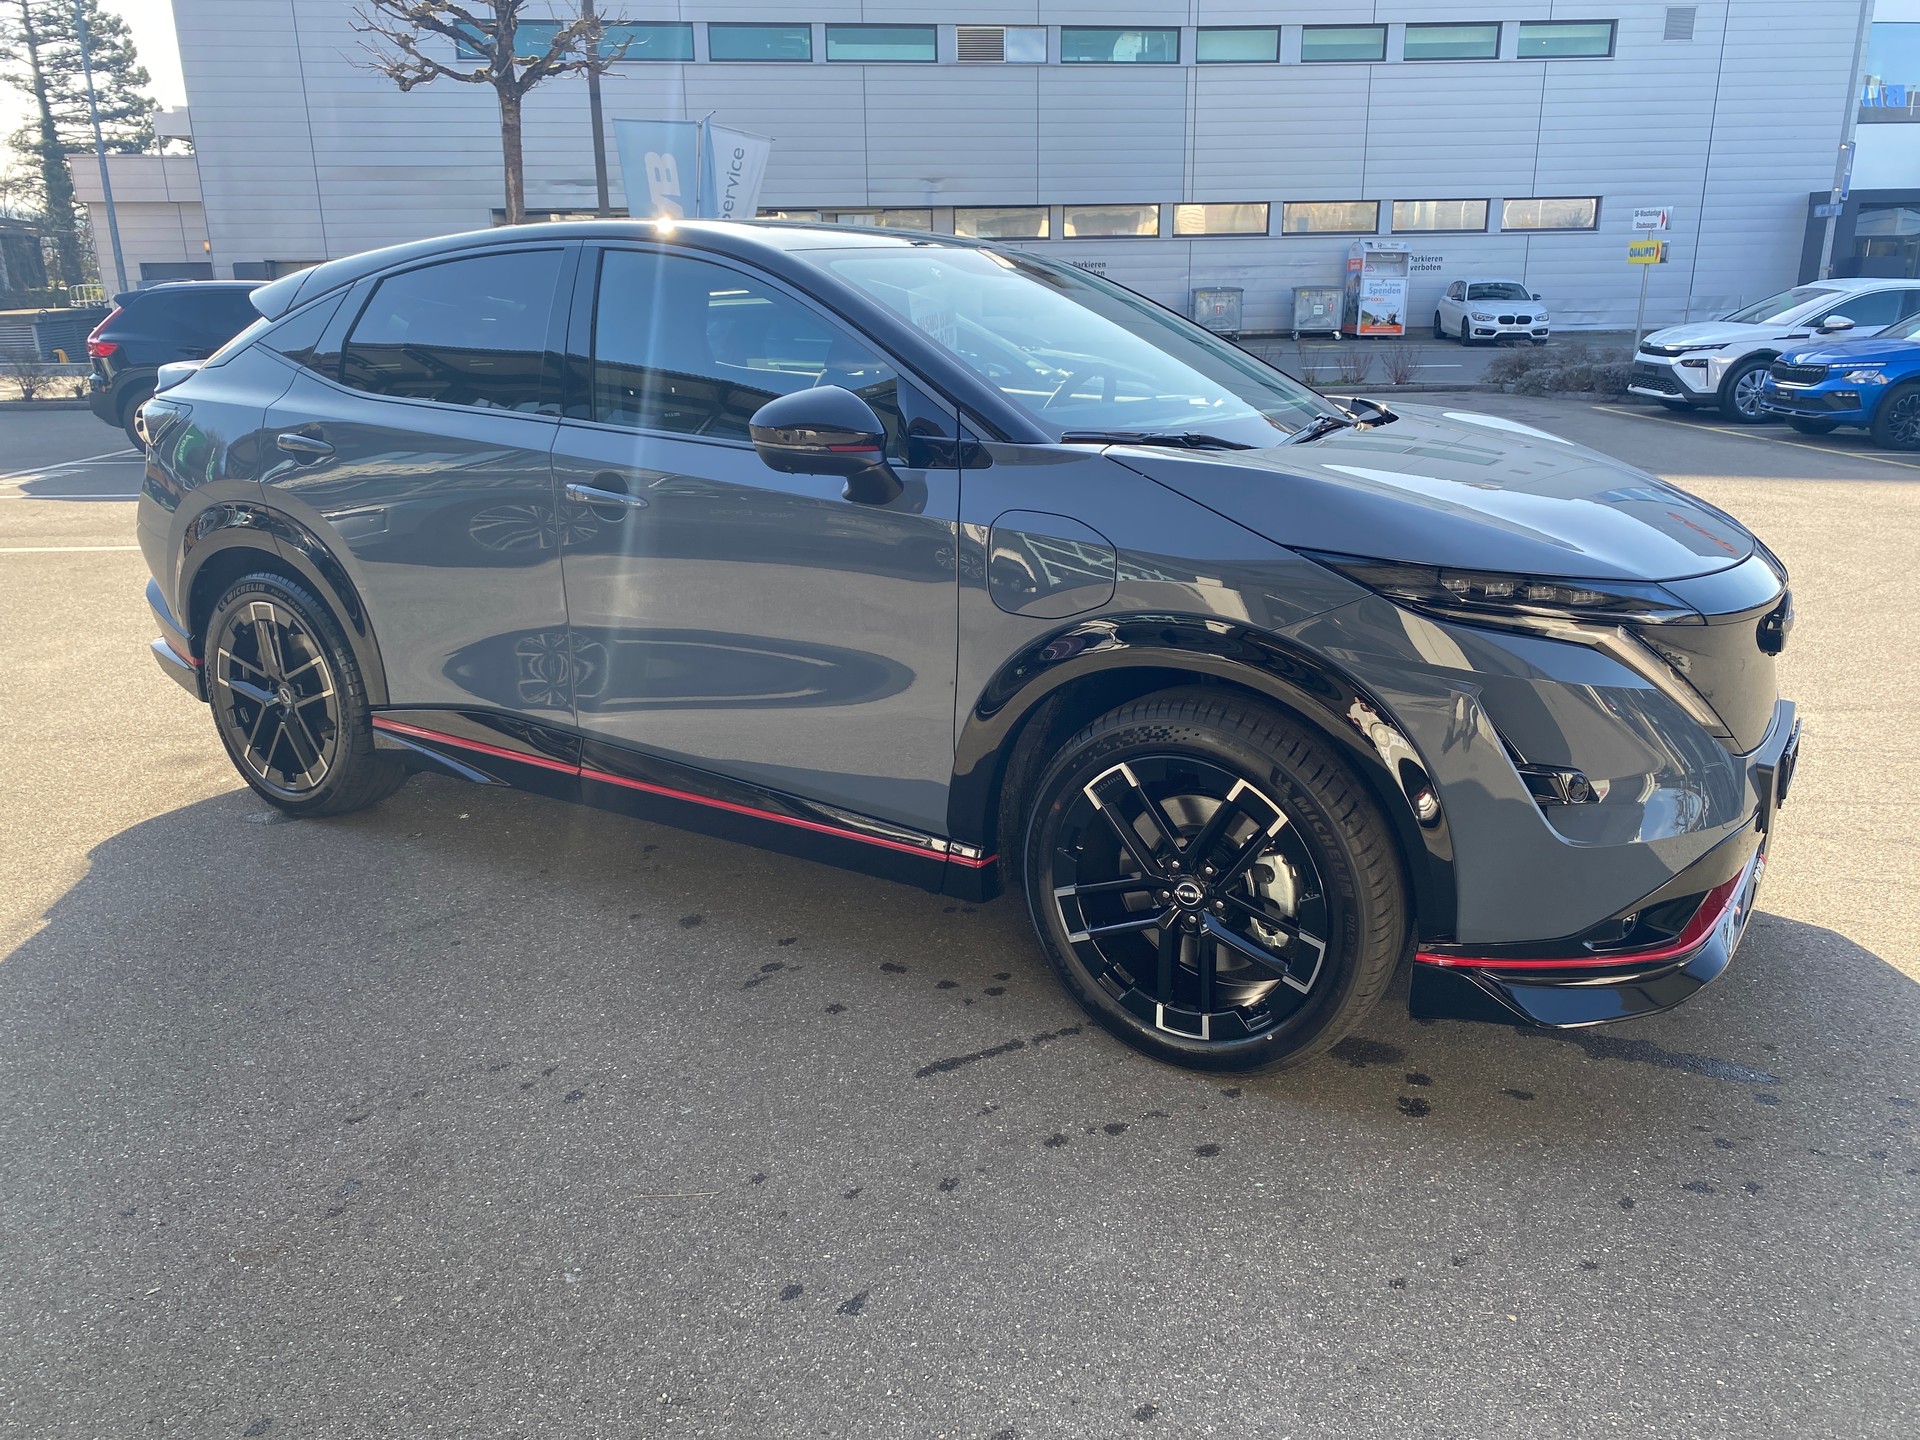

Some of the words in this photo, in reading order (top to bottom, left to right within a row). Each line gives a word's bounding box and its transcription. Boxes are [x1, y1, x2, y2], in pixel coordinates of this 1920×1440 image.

[1629, 246, 1656, 258] QUALIPET
[1369, 287, 1401, 295] Spenden
[226, 583, 266, 603] MICHELIN
[1292, 795, 1354, 898] MICHELIN
[1174, 889, 1203, 899] NISSAN
